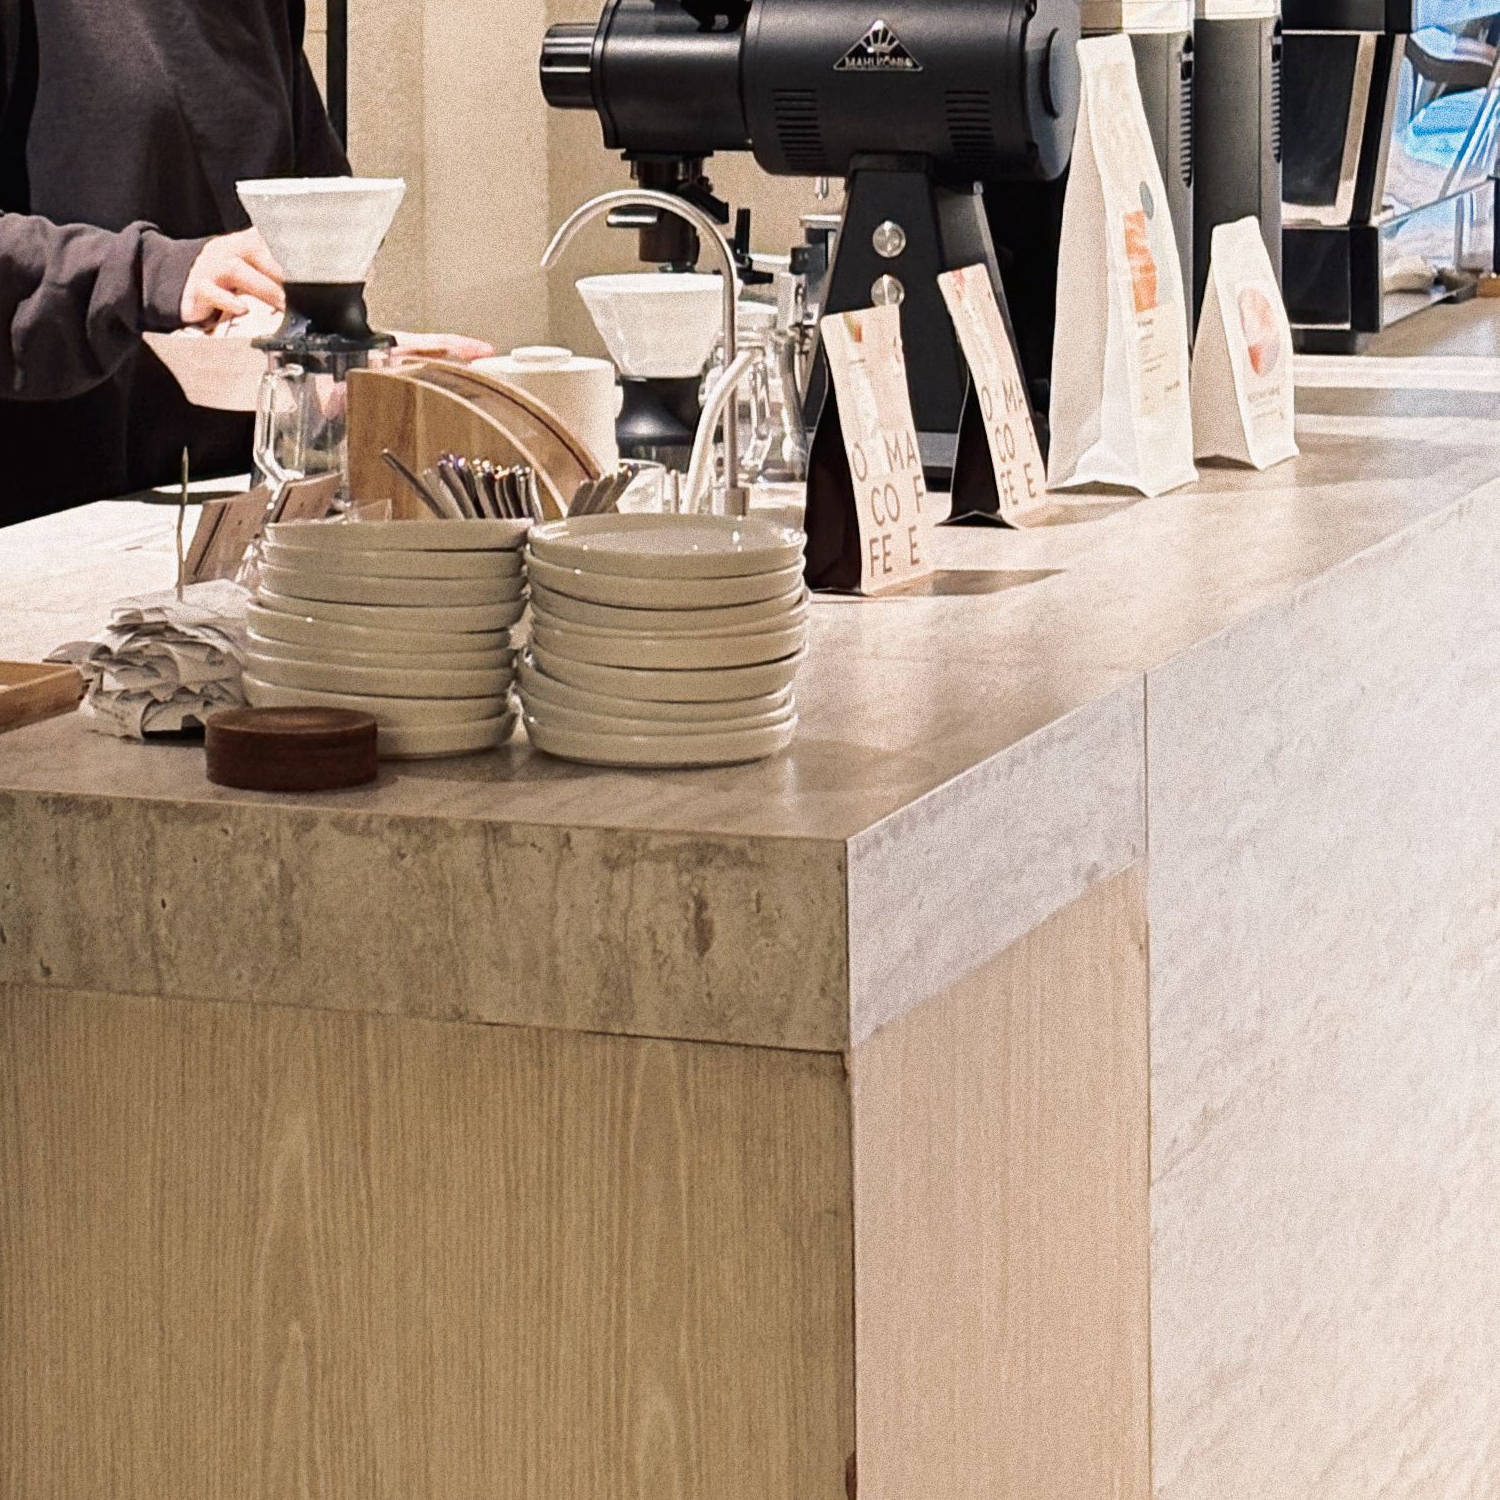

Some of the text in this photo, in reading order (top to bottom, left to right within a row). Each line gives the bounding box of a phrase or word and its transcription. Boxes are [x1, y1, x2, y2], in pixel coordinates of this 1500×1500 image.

[980, 386, 993, 422] O
[851, 429, 918, 482] O MA
[994, 422, 1016, 464] CO
[871, 474, 924, 527] CO F
[1000, 462, 1037, 510] FE E
[869, 525, 920, 577] FE E
